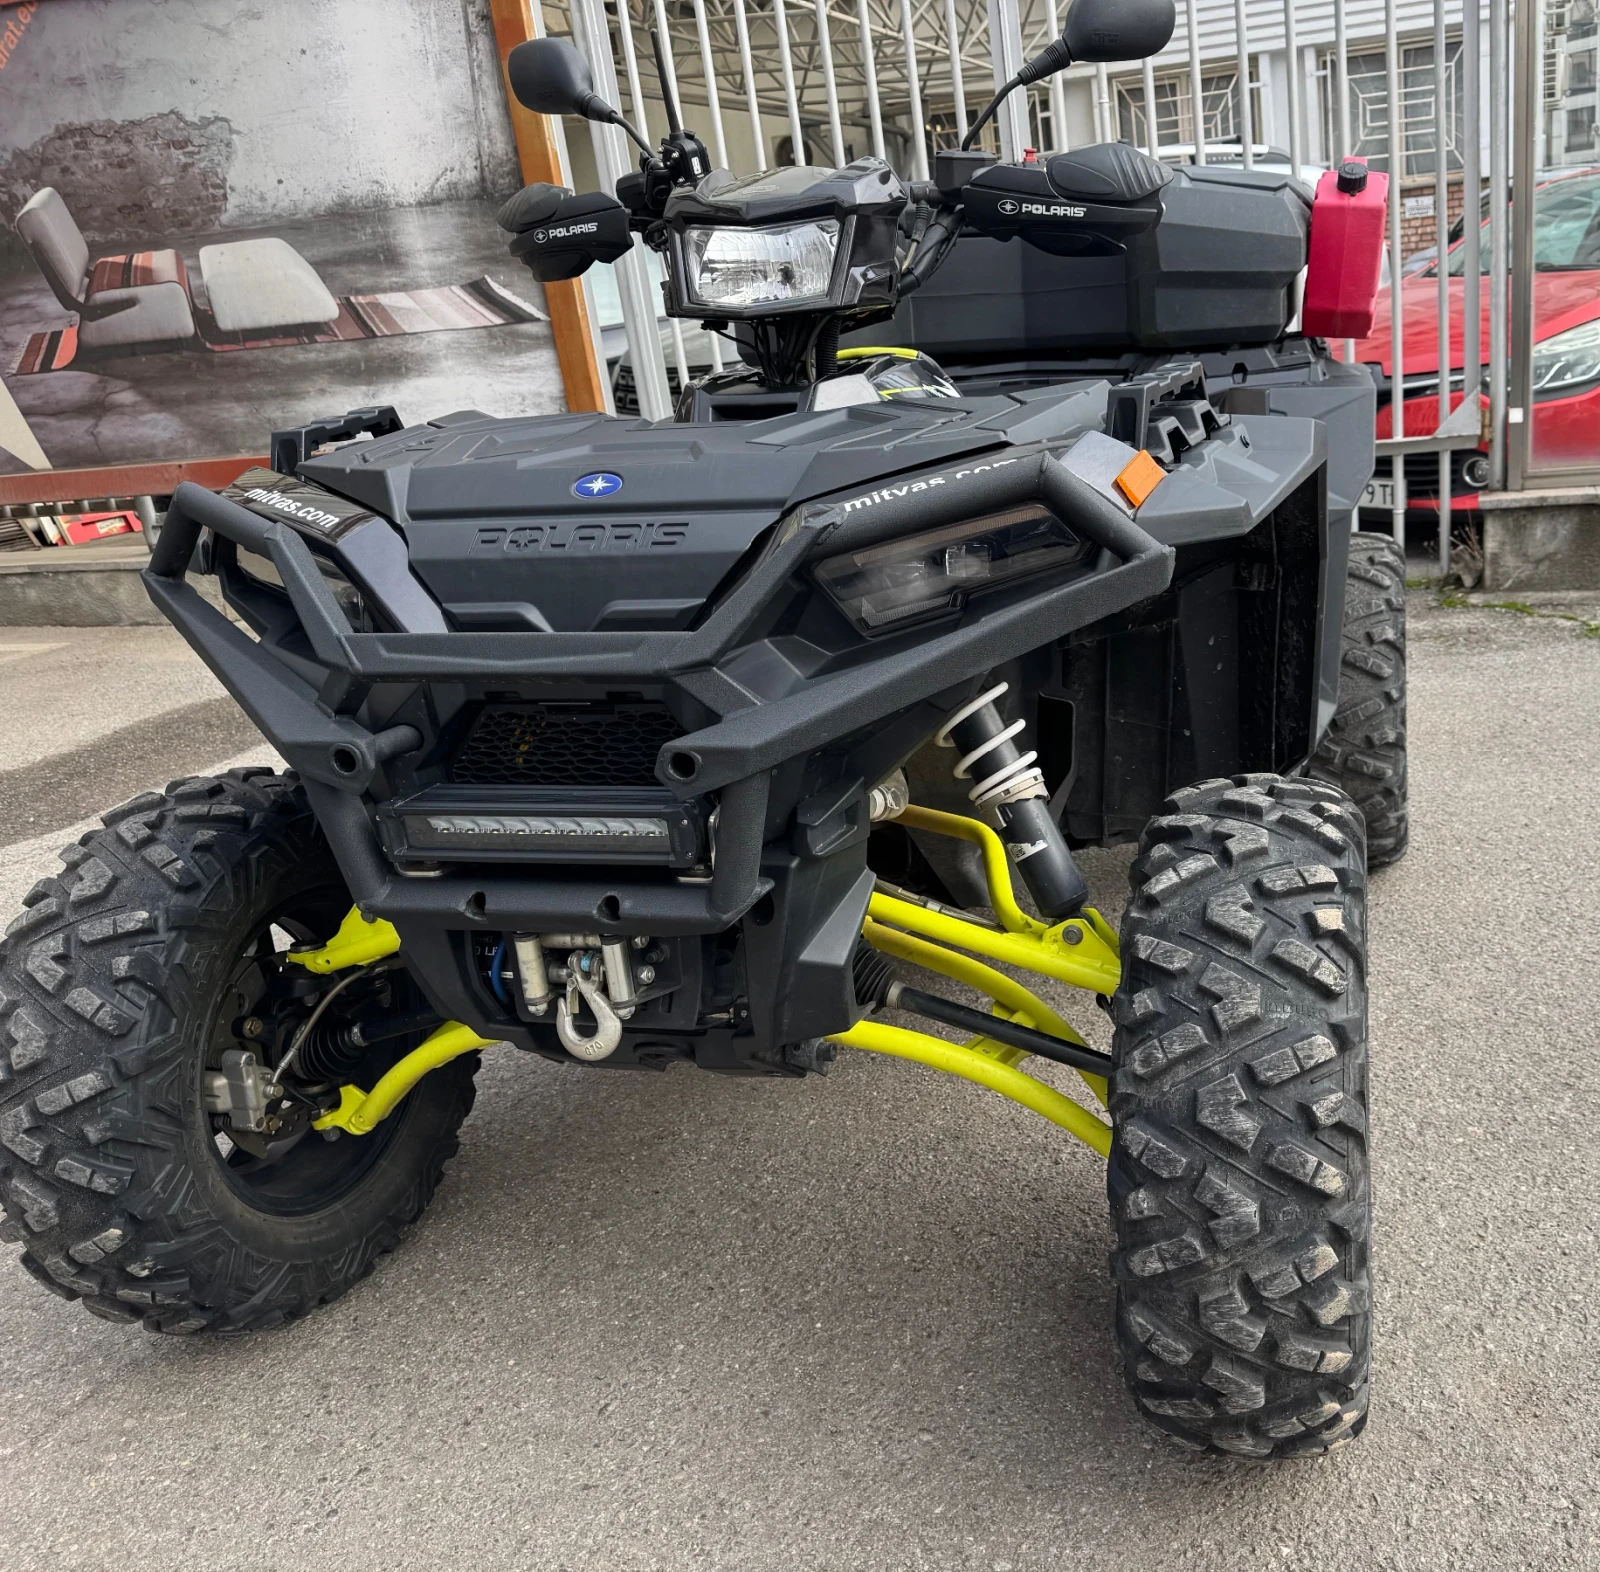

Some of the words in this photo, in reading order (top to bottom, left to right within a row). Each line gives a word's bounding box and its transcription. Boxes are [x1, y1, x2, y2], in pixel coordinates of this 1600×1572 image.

[1021, 203, 1085, 217] POLARIS
[548, 222, 598, 239] POLARIS
[843, 458, 1018, 512] mitvasco
[244, 488, 340, 527] mitvas.com
[467, 522, 690, 555] POLARIS
[584, 1040, 604, 1056] G70
